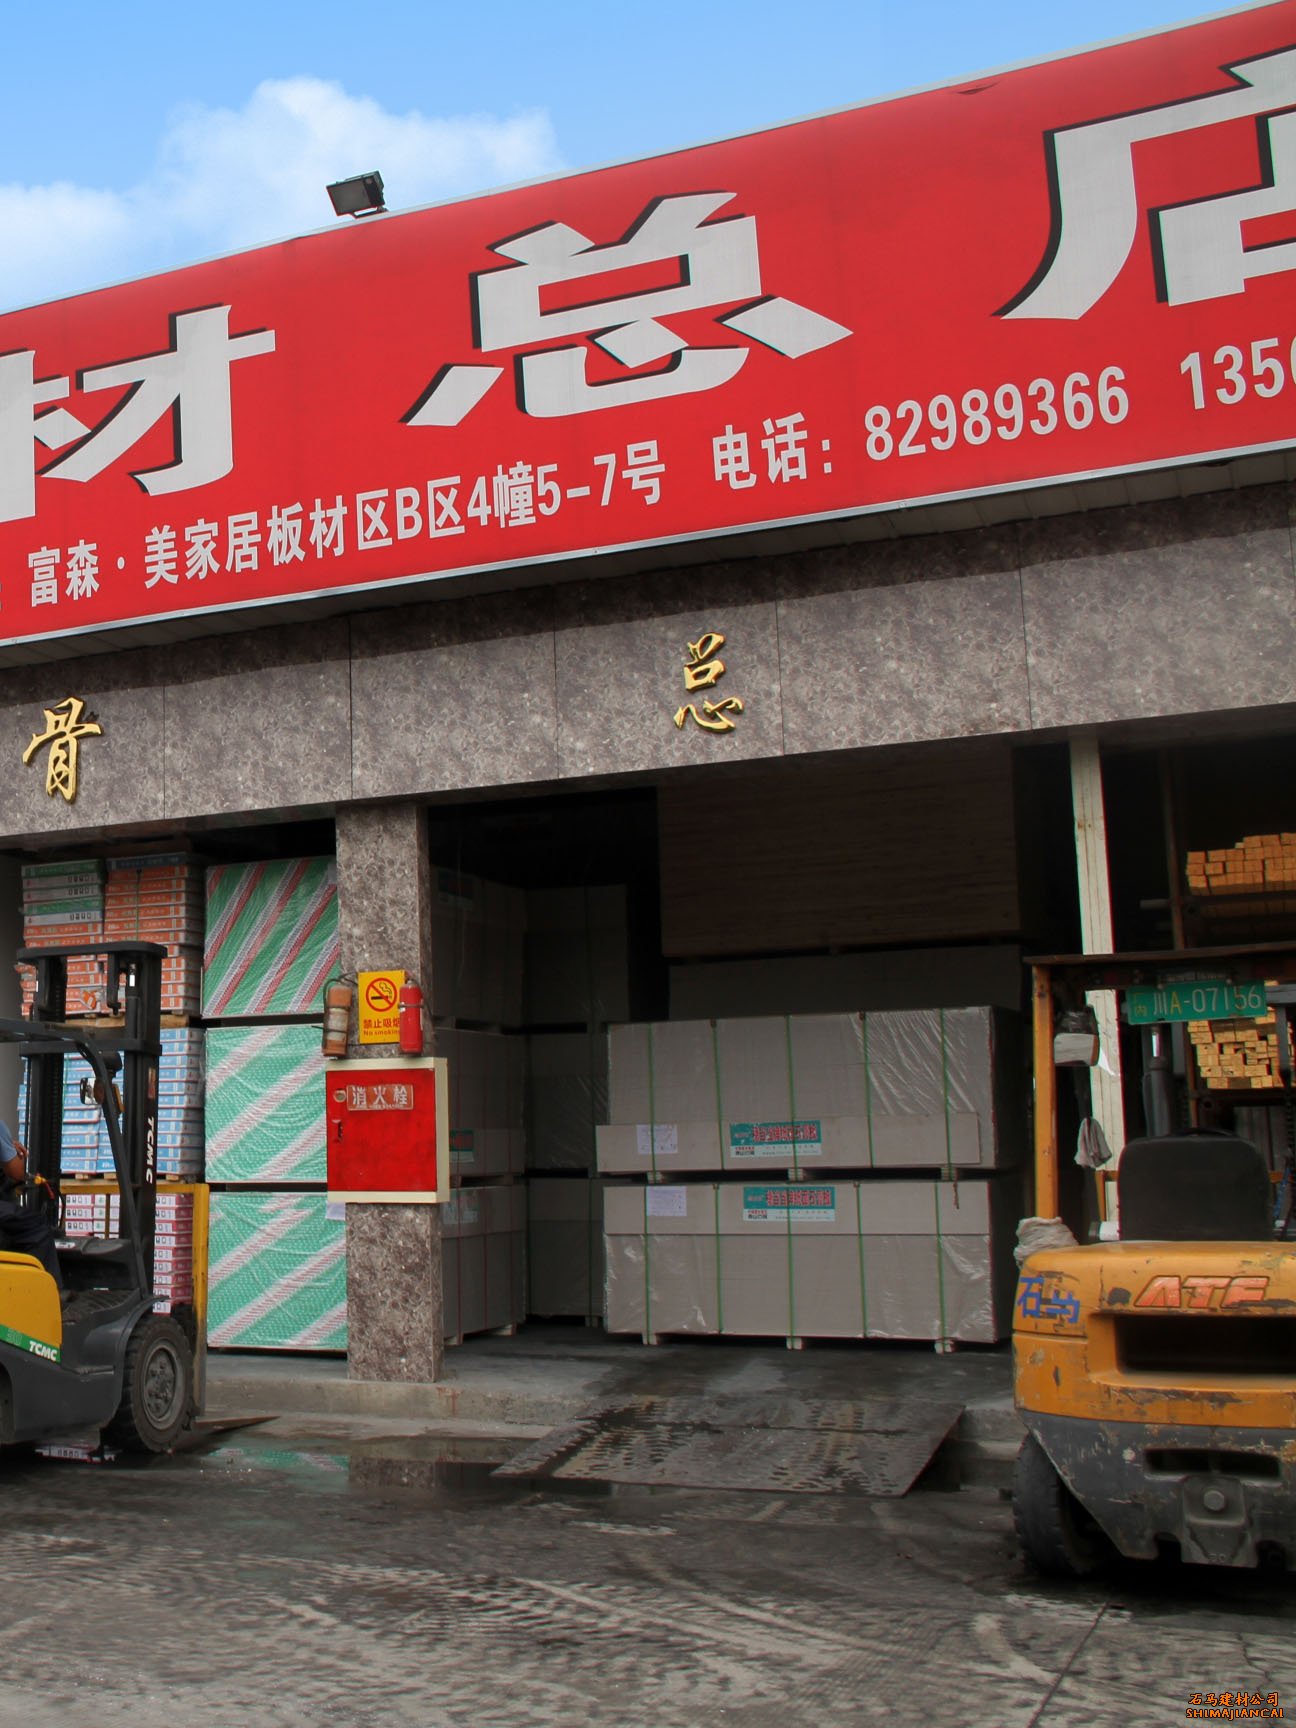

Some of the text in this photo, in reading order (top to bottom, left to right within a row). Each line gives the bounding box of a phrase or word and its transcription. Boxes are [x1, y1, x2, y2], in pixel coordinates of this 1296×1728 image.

[864, 366, 1129, 461] 82989366
[351, 1085, 408, 1105] 消火栓
[29, 1340, 58, 1361] TCMC
